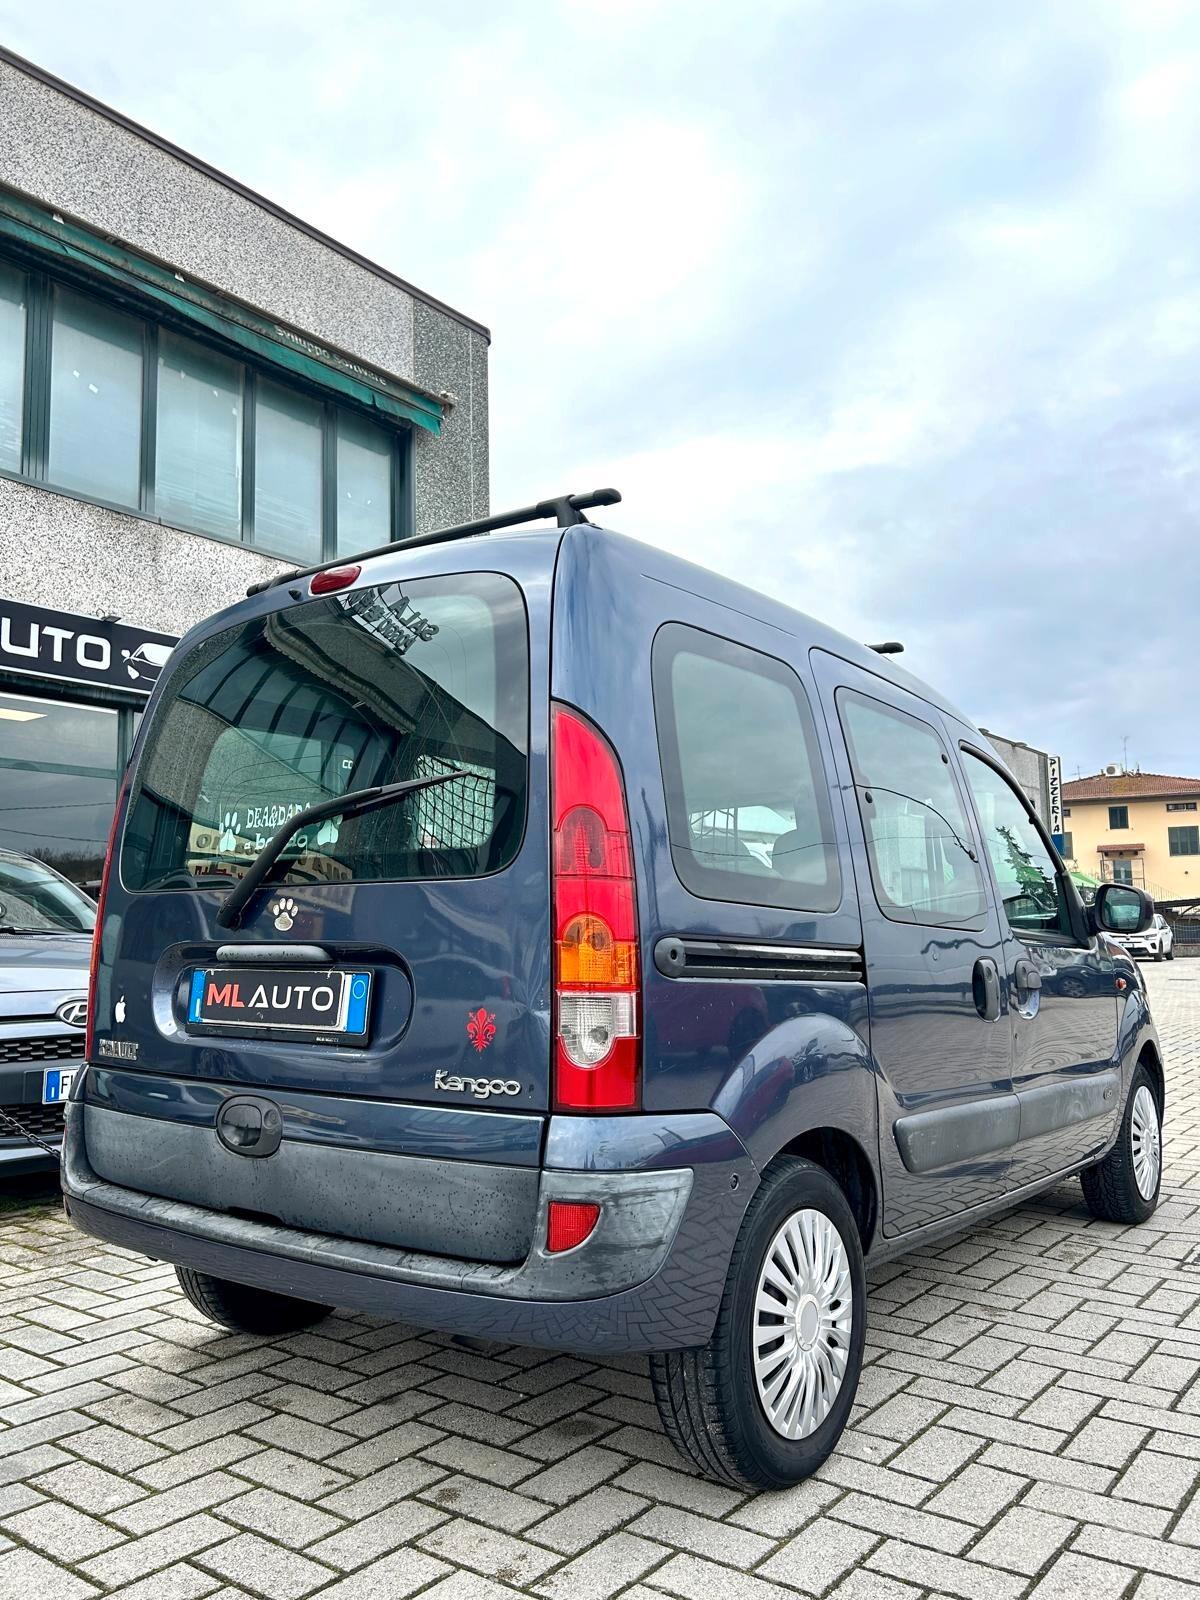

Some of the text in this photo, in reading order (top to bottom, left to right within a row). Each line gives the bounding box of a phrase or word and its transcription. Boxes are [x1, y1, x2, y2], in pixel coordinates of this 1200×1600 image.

[1, 617, 111, 671] UTO
[1049, 758, 1061, 834] PIZZERIA
[434, 1069, 521, 1099] Kangoo
